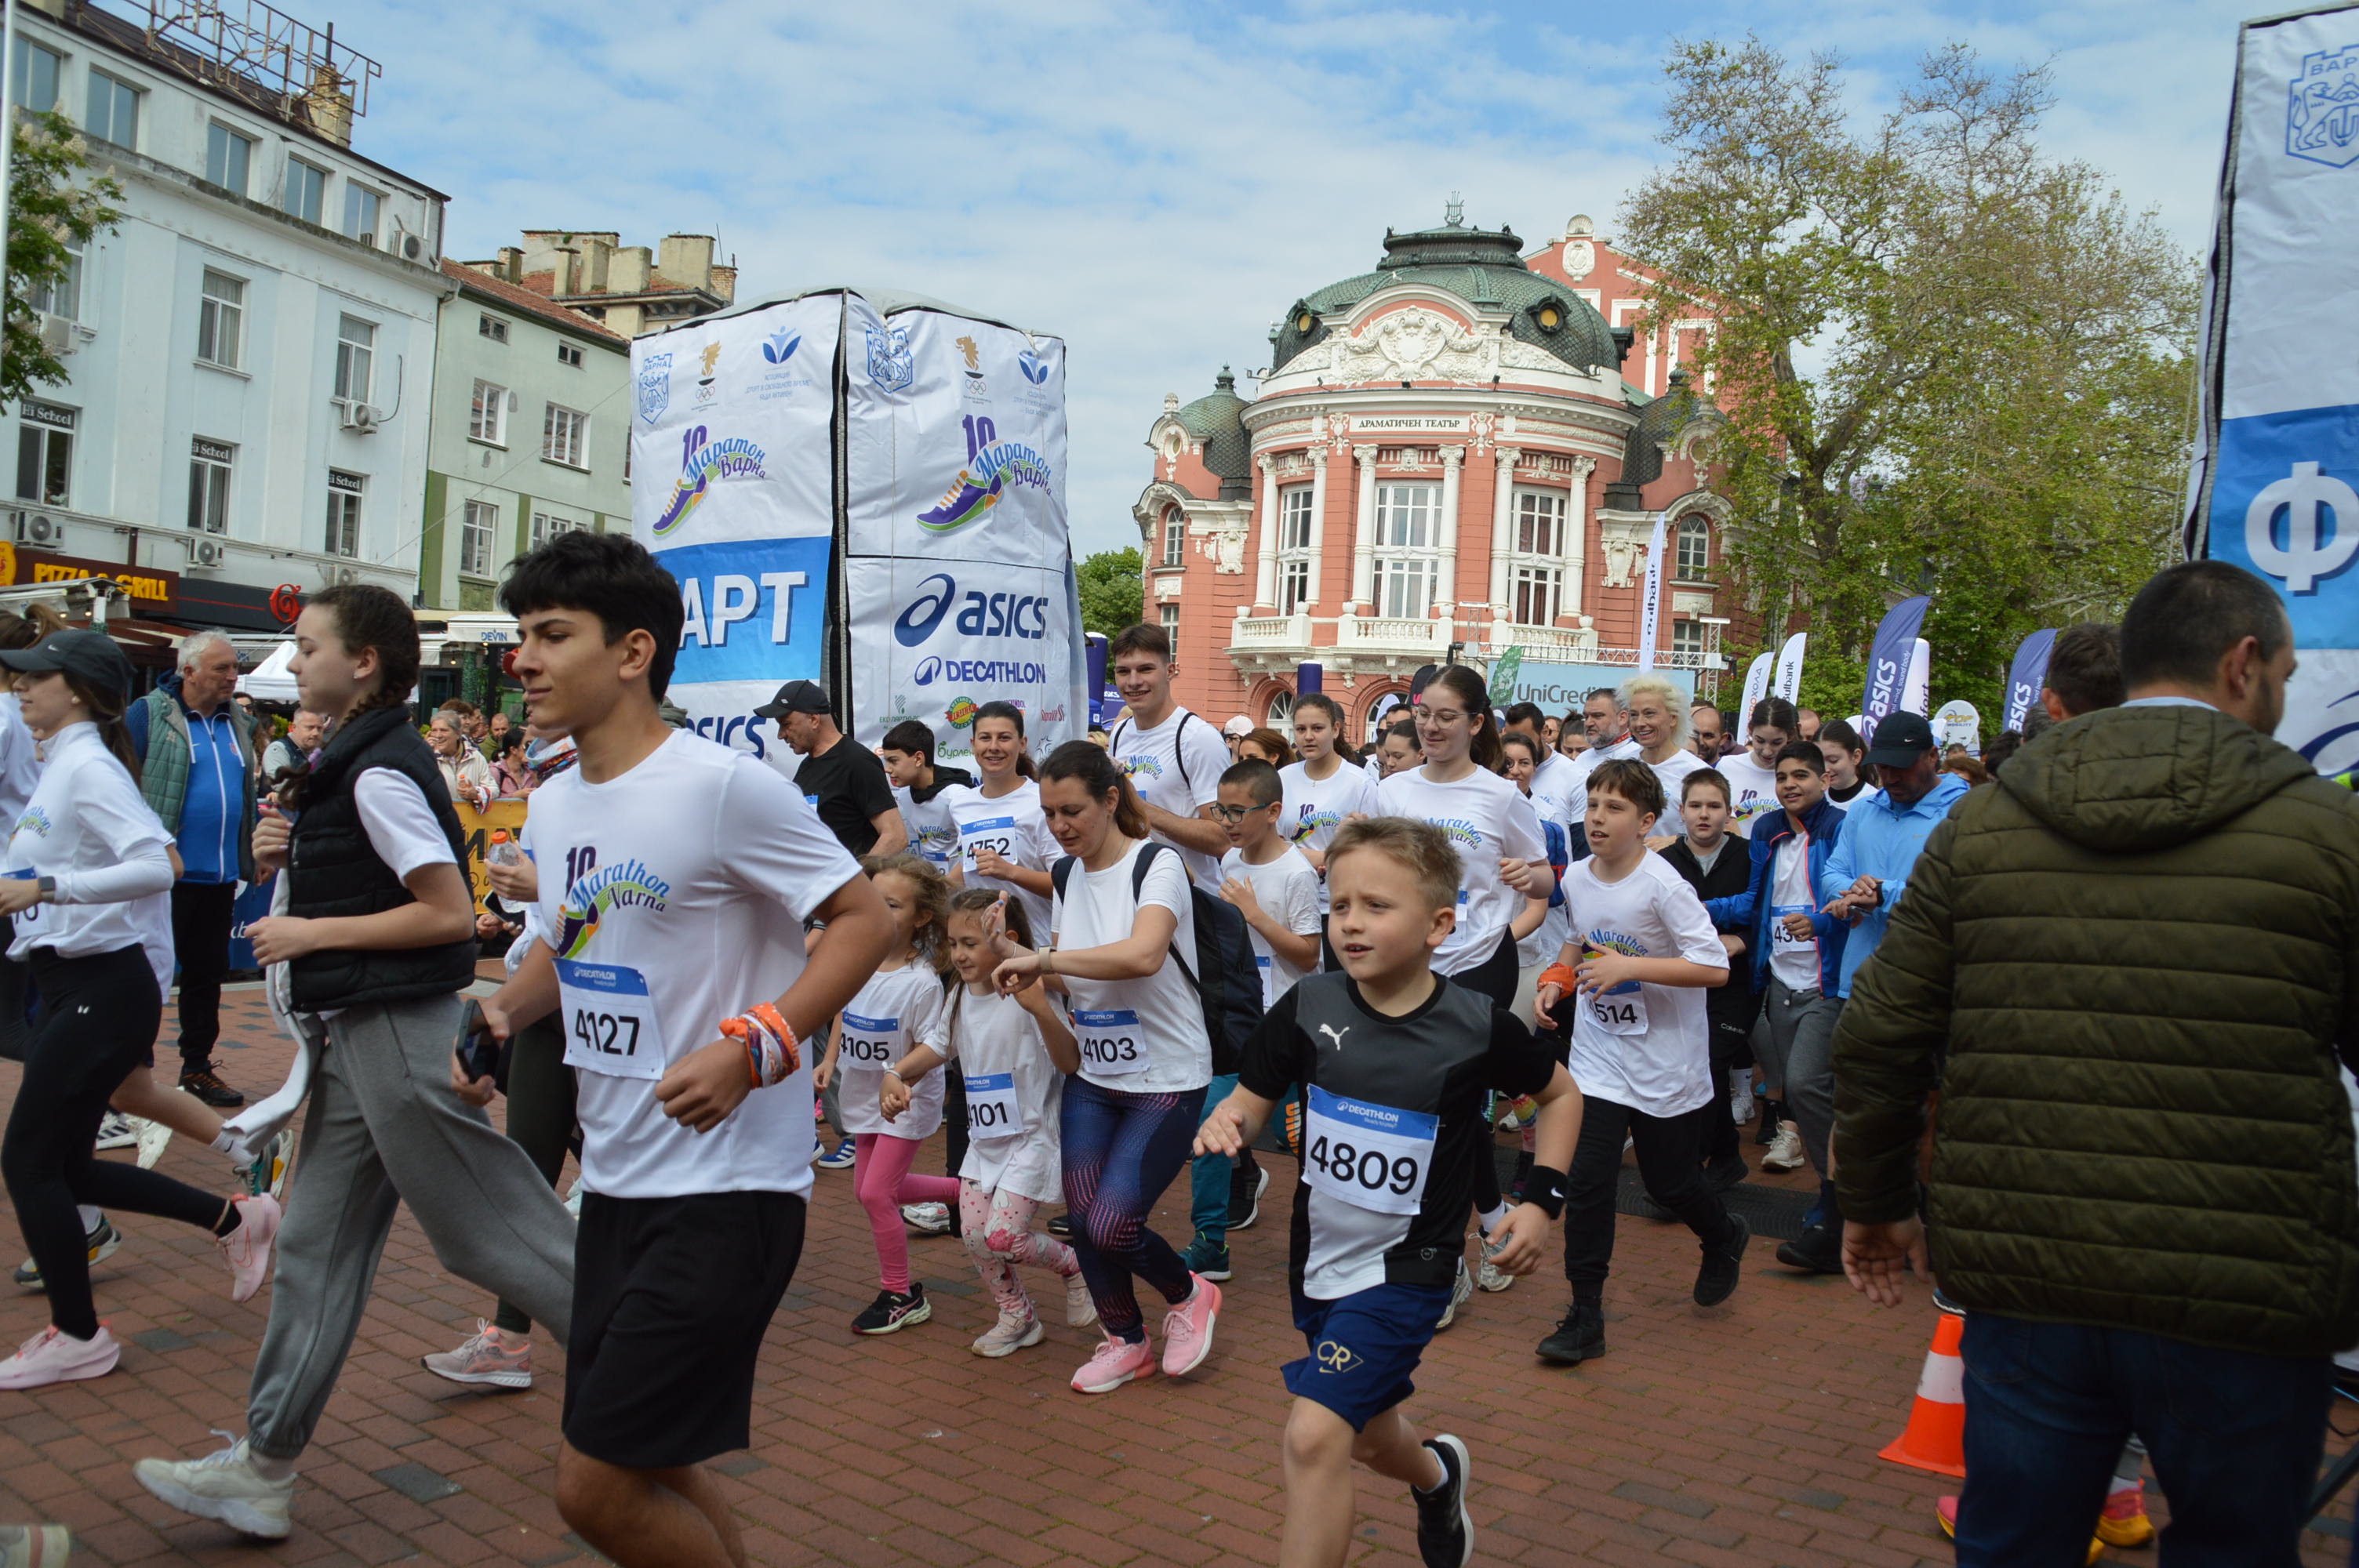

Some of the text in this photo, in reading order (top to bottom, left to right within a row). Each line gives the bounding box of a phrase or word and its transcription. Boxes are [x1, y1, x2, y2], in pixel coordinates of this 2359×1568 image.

[22, 404, 71, 426] Hi School
[1358, 419, 1421, 428] ДРАМАТИЧЕН
[201, 444, 230, 460] School
[682, 425, 707, 474] 10
[962, 414, 996, 468] 10
[686, 437, 765, 484] Маратон
[718, 455, 766, 479] Варна
[975, 442, 1051, 485] Маратон
[336, 474, 361, 490] School
[1011, 460, 1052, 496] Варна
[2245, 461, 2359, 591] Ф
[34, 563, 89, 583] PIZZA
[115, 574, 169, 602] GRILL
[482, 630, 507, 641] DEVIN
[945, 660, 1046, 684] DECATHLON
[1518, 683, 1597, 705] UniCred
[1302, 811, 1341, 827] Maratho
[565, 846, 596, 900] 10
[571, 858, 671, 916] Marathon
[607, 883, 667, 913] Varna
[1589, 928, 1648, 956] Marathon
[575, 1008, 640, 1057] 4127
[841, 1032, 890, 1062] 4105
[1083, 1037, 1137, 1063] 4103
[1348, 1103, 1399, 1123] DECATHLON
[1310, 1135, 1419, 1196] 4809
